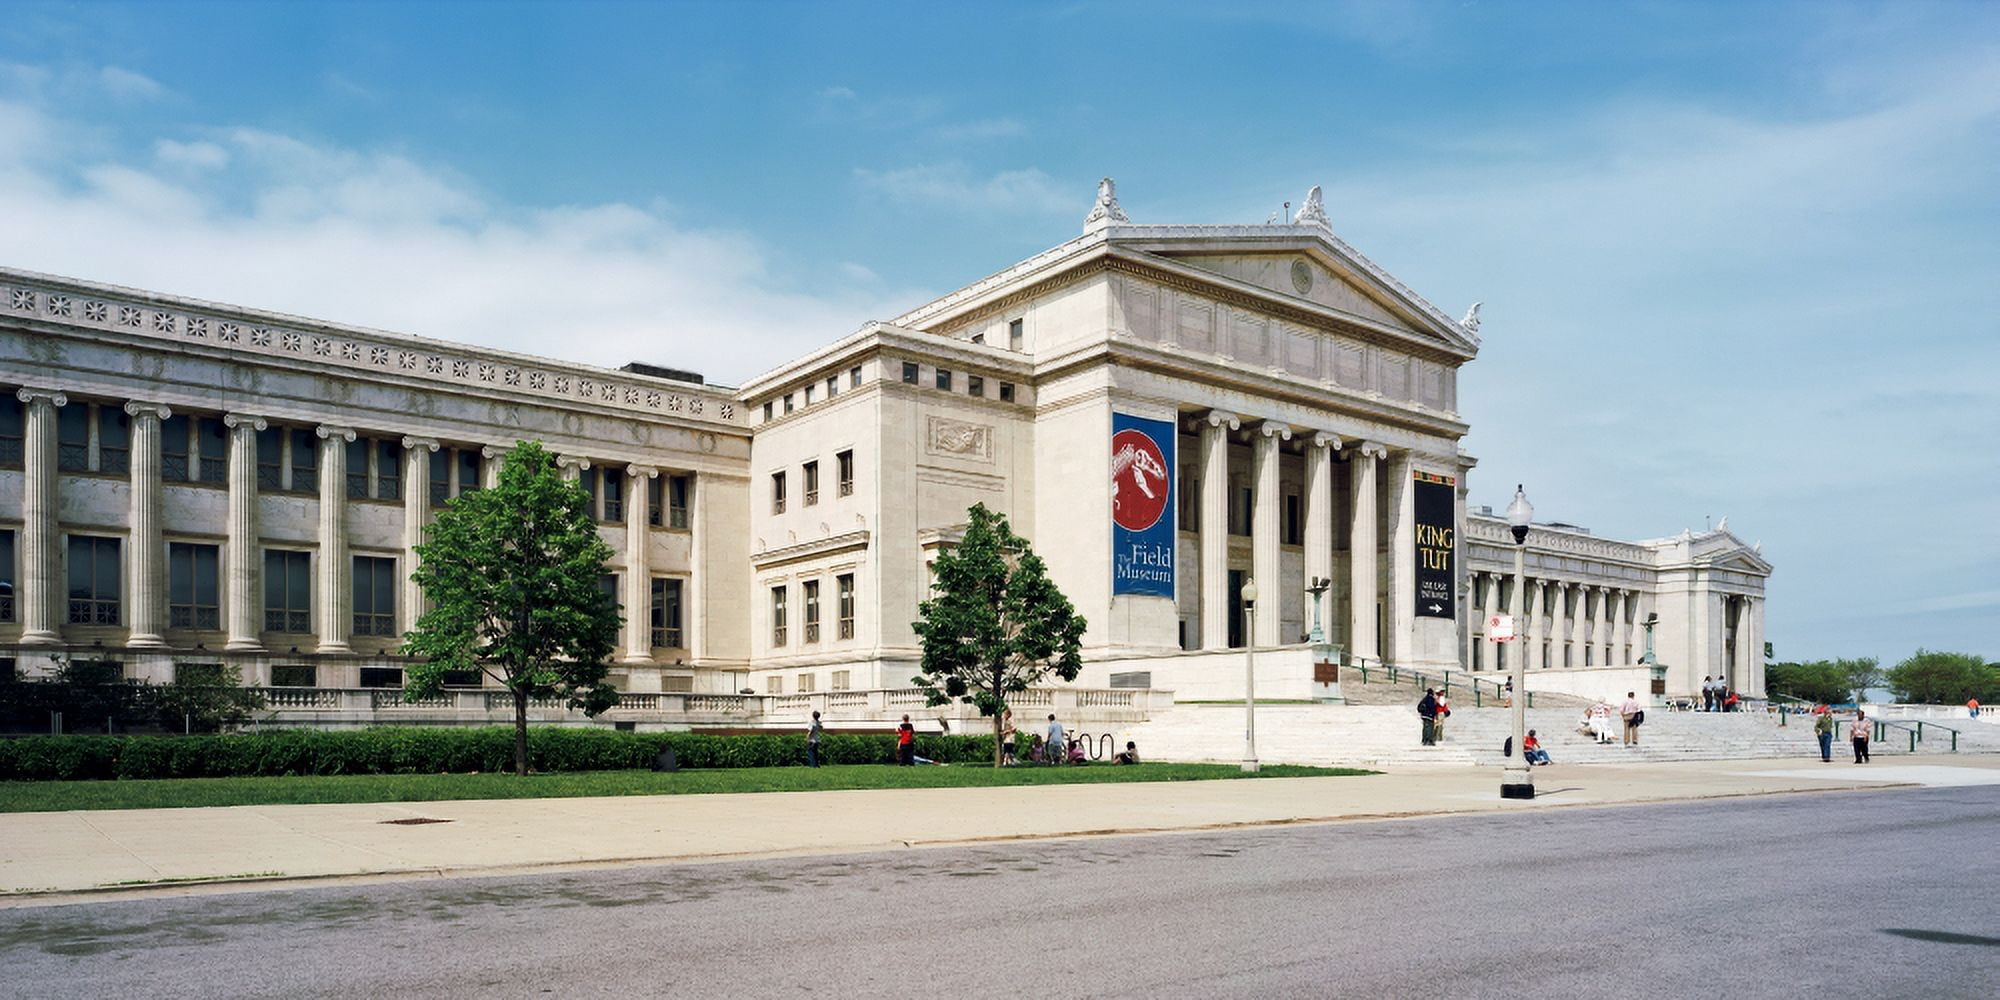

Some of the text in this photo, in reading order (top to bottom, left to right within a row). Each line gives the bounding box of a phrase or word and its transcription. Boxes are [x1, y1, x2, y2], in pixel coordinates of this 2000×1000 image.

[1416, 523, 1453, 549] KING
[1132, 543, 1171, 568] Field
[1420, 547, 1450, 571] TUT
[1117, 563, 1171, 583] Museum
